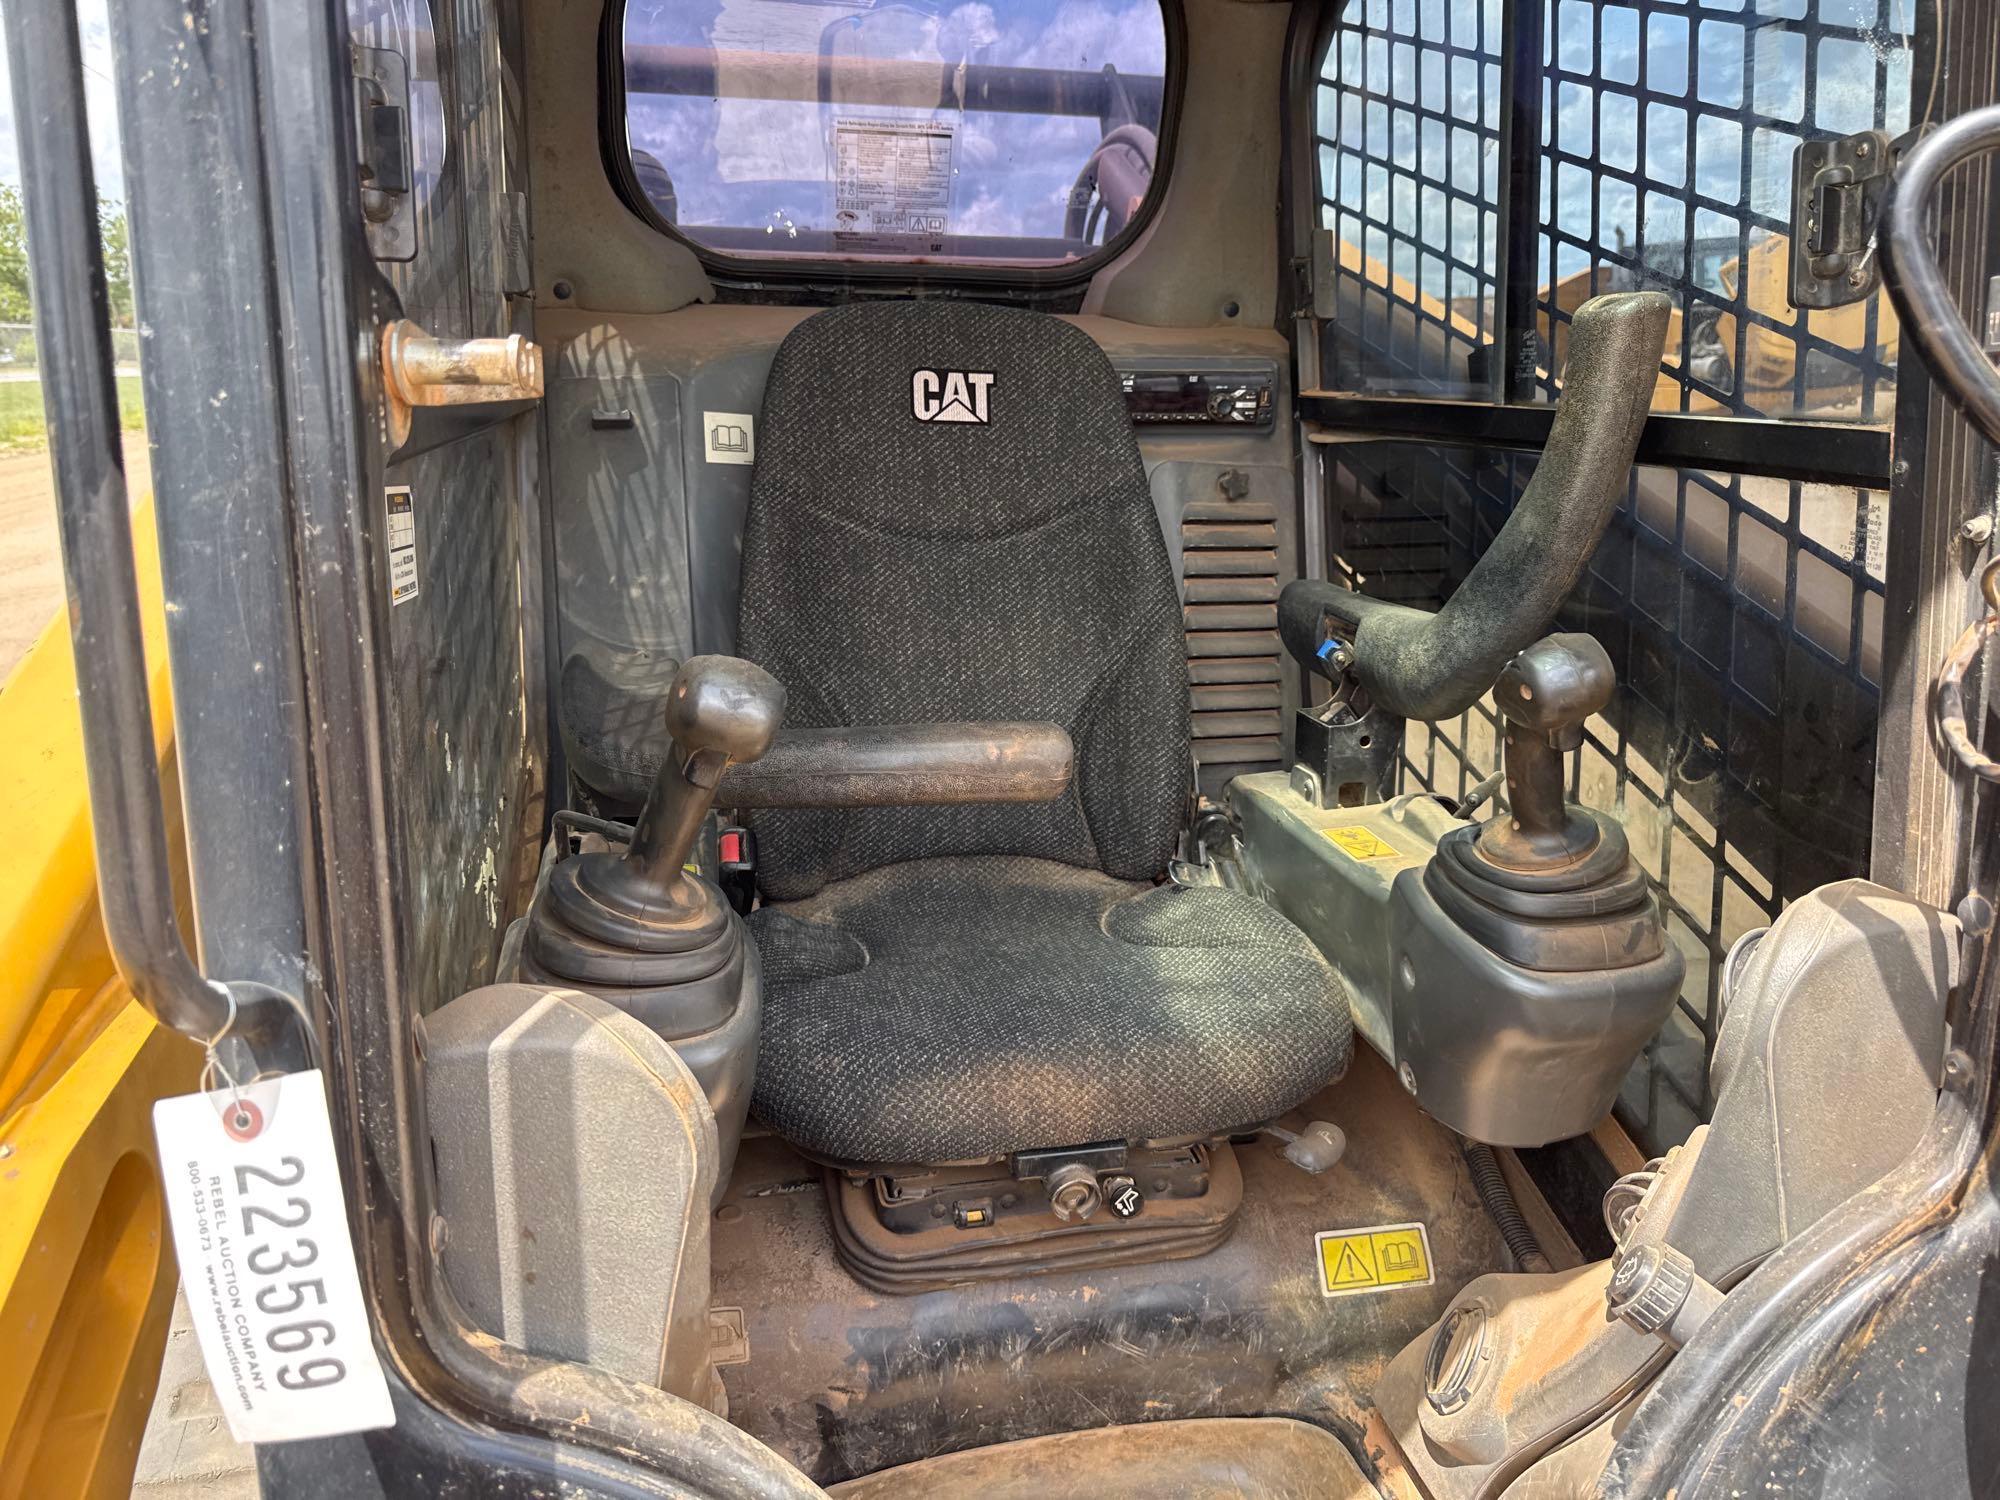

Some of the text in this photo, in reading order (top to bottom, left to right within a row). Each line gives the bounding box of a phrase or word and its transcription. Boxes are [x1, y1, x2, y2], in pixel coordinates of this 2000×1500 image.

[912, 369, 995, 423] CAT
[205, 1264, 254, 1411] www.rebelauction.com
[209, 1176, 267, 1392] REBEL AUCTION COMPANY
[234, 1156, 346, 1391] 223569
